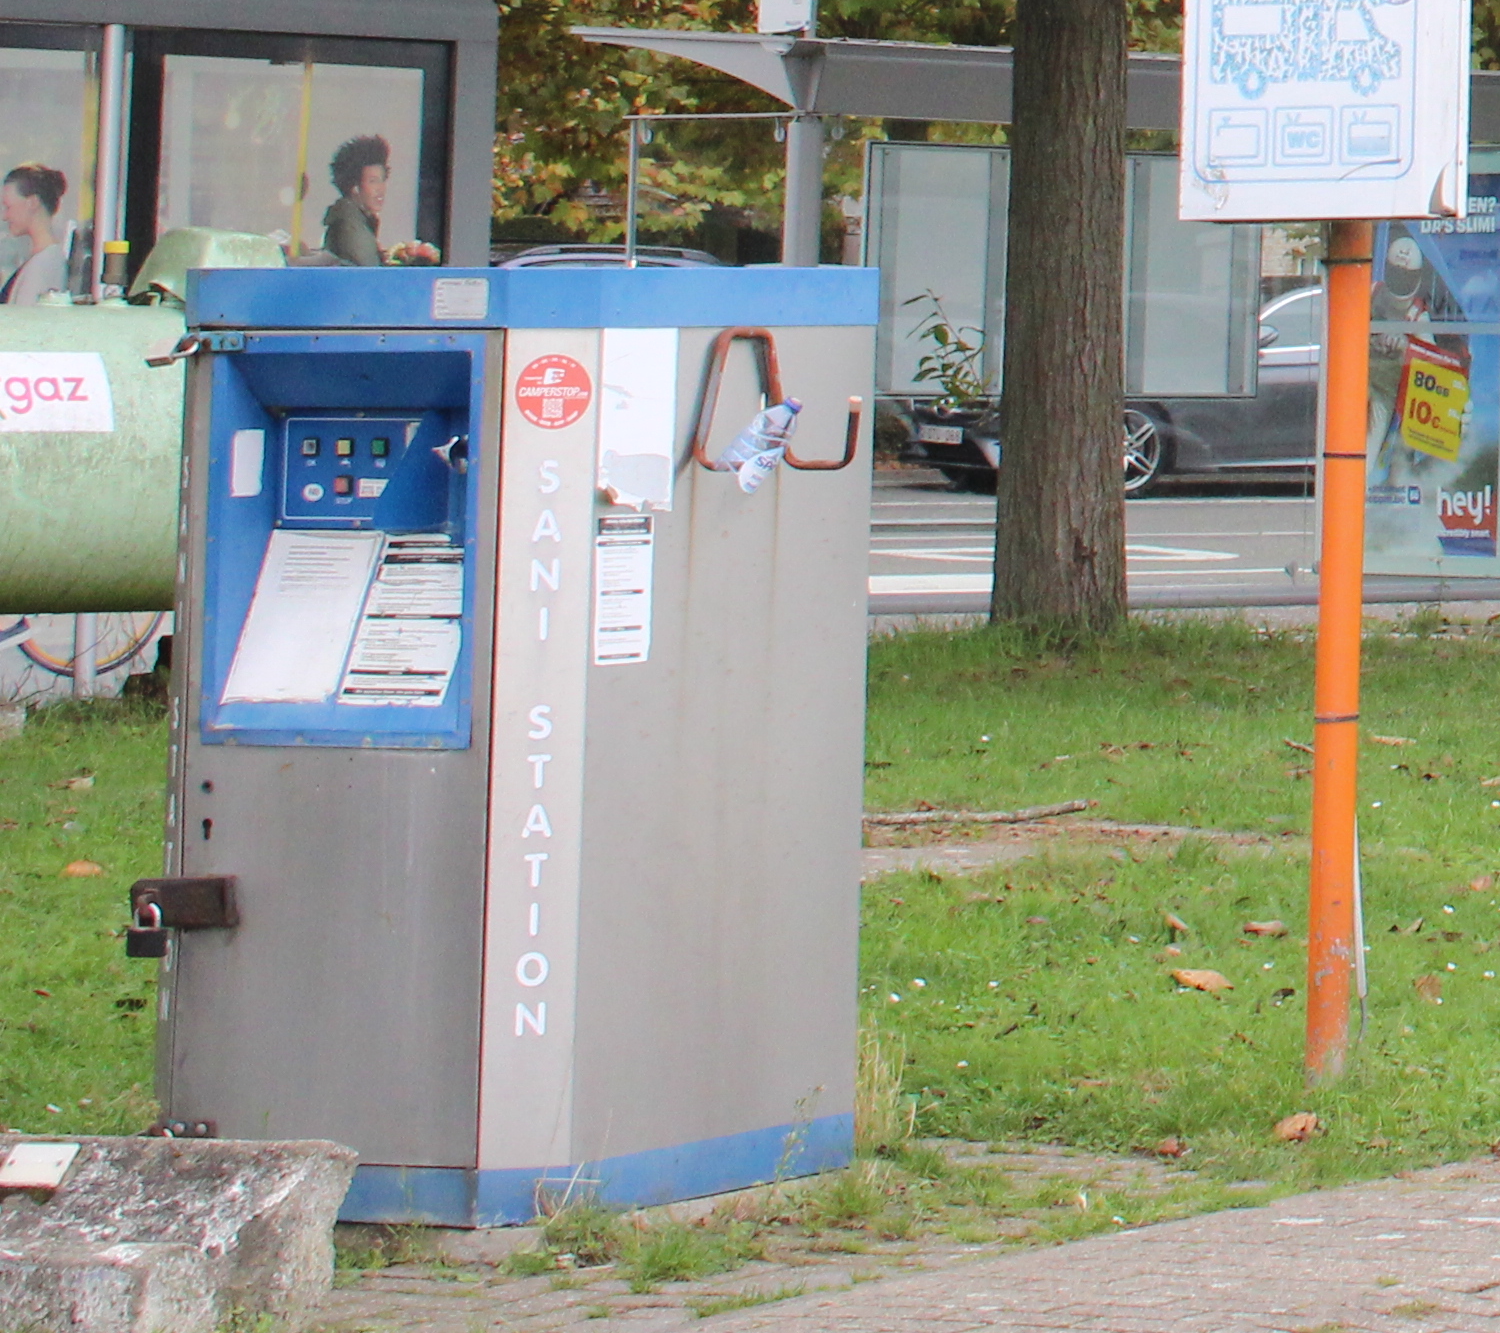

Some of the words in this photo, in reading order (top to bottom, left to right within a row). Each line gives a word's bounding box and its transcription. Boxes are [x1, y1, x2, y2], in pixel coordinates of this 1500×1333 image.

[1286, 131, 1322, 149] WC
[1468, 196, 1497, 213] EN?
[1456, 217, 1496, 233] SLIM!
[0, 376, 89, 415] gaz
[1436, 484, 1492, 526] hey!
[528, 460, 562, 641] SANI
[515, 704, 553, 1038] STATION
